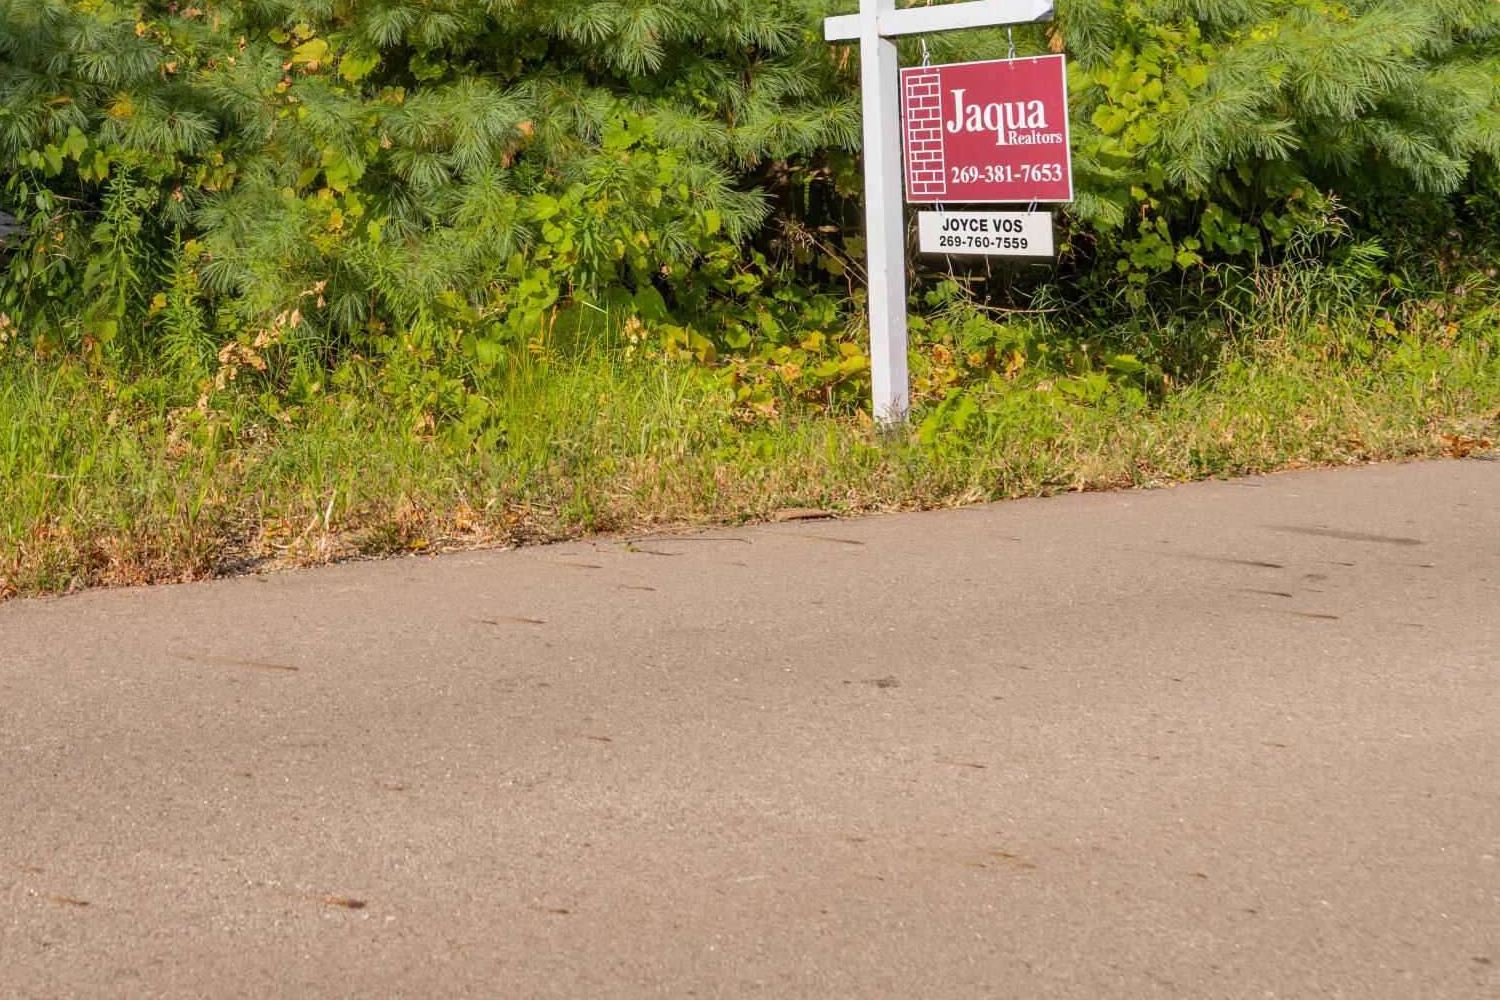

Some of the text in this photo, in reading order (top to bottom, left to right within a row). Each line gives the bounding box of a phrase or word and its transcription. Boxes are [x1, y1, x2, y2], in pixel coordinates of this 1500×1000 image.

[947, 88, 1048, 146] Jaqua
[1008, 130, 1063, 145] Realtors
[951, 164, 1063, 183] 269-381-7653
[942, 218, 1023, 233] JOYCE VOS
[939, 235, 1028, 249] 269-760-7559
